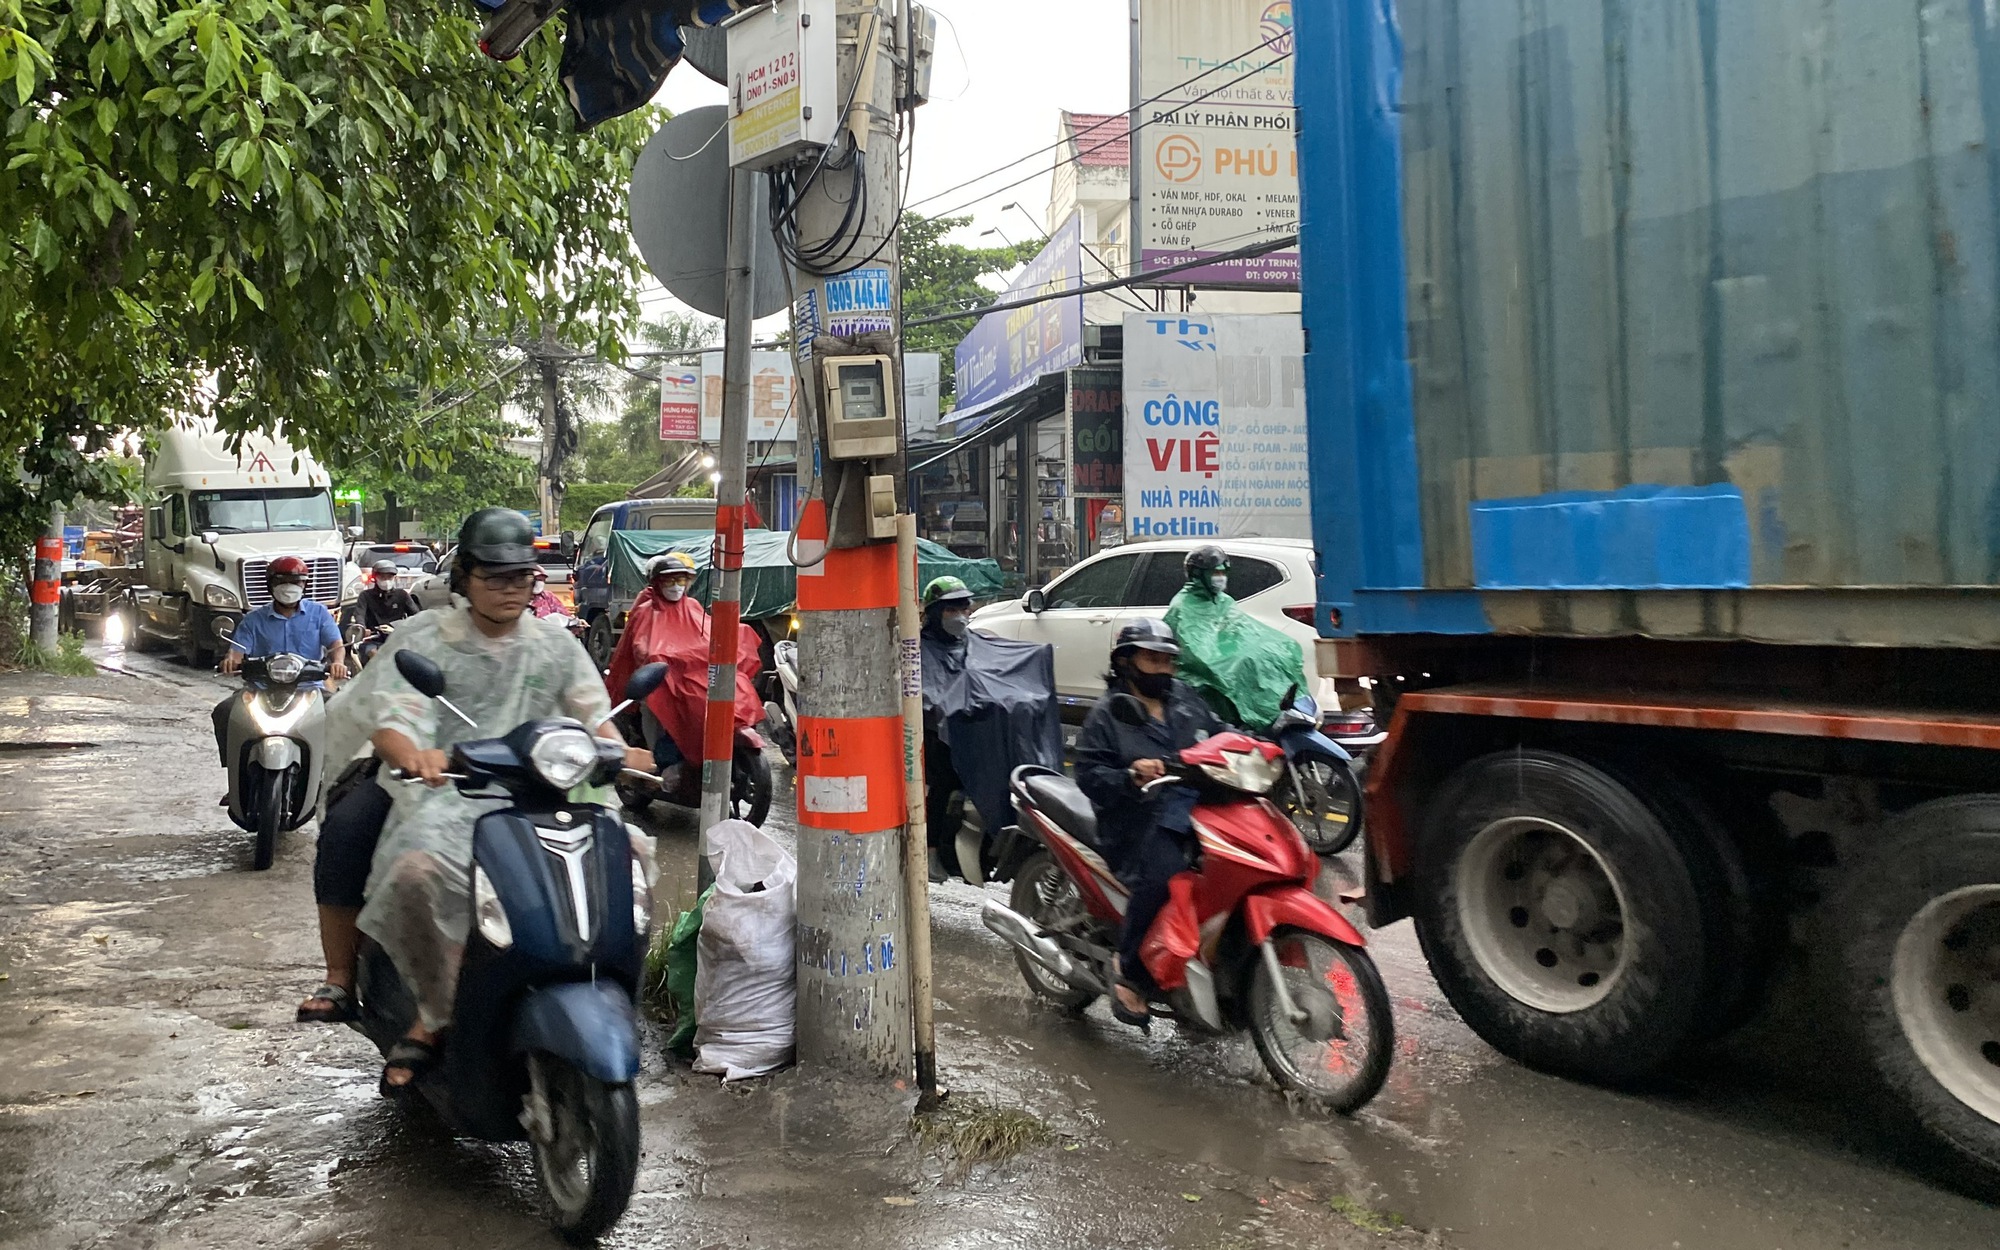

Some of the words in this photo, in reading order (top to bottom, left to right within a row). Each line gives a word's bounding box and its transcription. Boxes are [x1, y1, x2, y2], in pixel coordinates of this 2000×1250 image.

[747, 66, 766, 84] HCM
[769, 52, 794, 75] 1202
[1177, 56, 1283, 74] THANH
[746, 69, 796, 101] DN01-SN09
[1236, 87, 1261, 100] thất
[1266, 89, 1275, 100] &
[754, 92, 797, 120] INTERNET
[1153, 111, 1179, 127] ĐẠI
[1185, 110, 1200, 125] LÝ
[1205, 112, 1249, 127] PHÂN
[1254, 112, 1290, 129] PHỐI
[1215, 143, 1278, 177] PHÚ
[1160, 188, 1179, 200] VÁN
[1204, 192, 1223, 203] HDF,
[1225, 192, 1247, 202] OKAL
[1161, 205, 1179, 216] TẤM
[1182, 206, 1207, 217] NHỰA
[1209, 208, 1243, 217] DURABO
[1265, 209, 1296, 218] VENEER
[1176, 221, 1197, 231] GHÉP
[1160, 235, 1178, 246] VÁN
[1181, 235, 1191, 246] ÉP
[1245, 259, 1266, 268] DUY
[1246, 272, 1260, 280] ĐT:
[1263, 272, 1288, 280] 0909
[1072, 389, 1121, 412] DRAP
[681, 406, 697, 414] PHÁT
[1144, 393, 1219, 426] CÔNG
[1077, 418, 1119, 452] GỐI
[1227, 443, 1245, 453] ALU
[1253, 443, 1281, 453] FOAM
[1073, 458, 1122, 493] NỆM
[1249, 475, 1286, 489] NGÀNH
[1141, 485, 1173, 508] NHÀ
[1179, 485, 1219, 508] PHÂN
[1254, 498, 1272, 507] GIA
[1274, 494, 1302, 507] CÔNG
